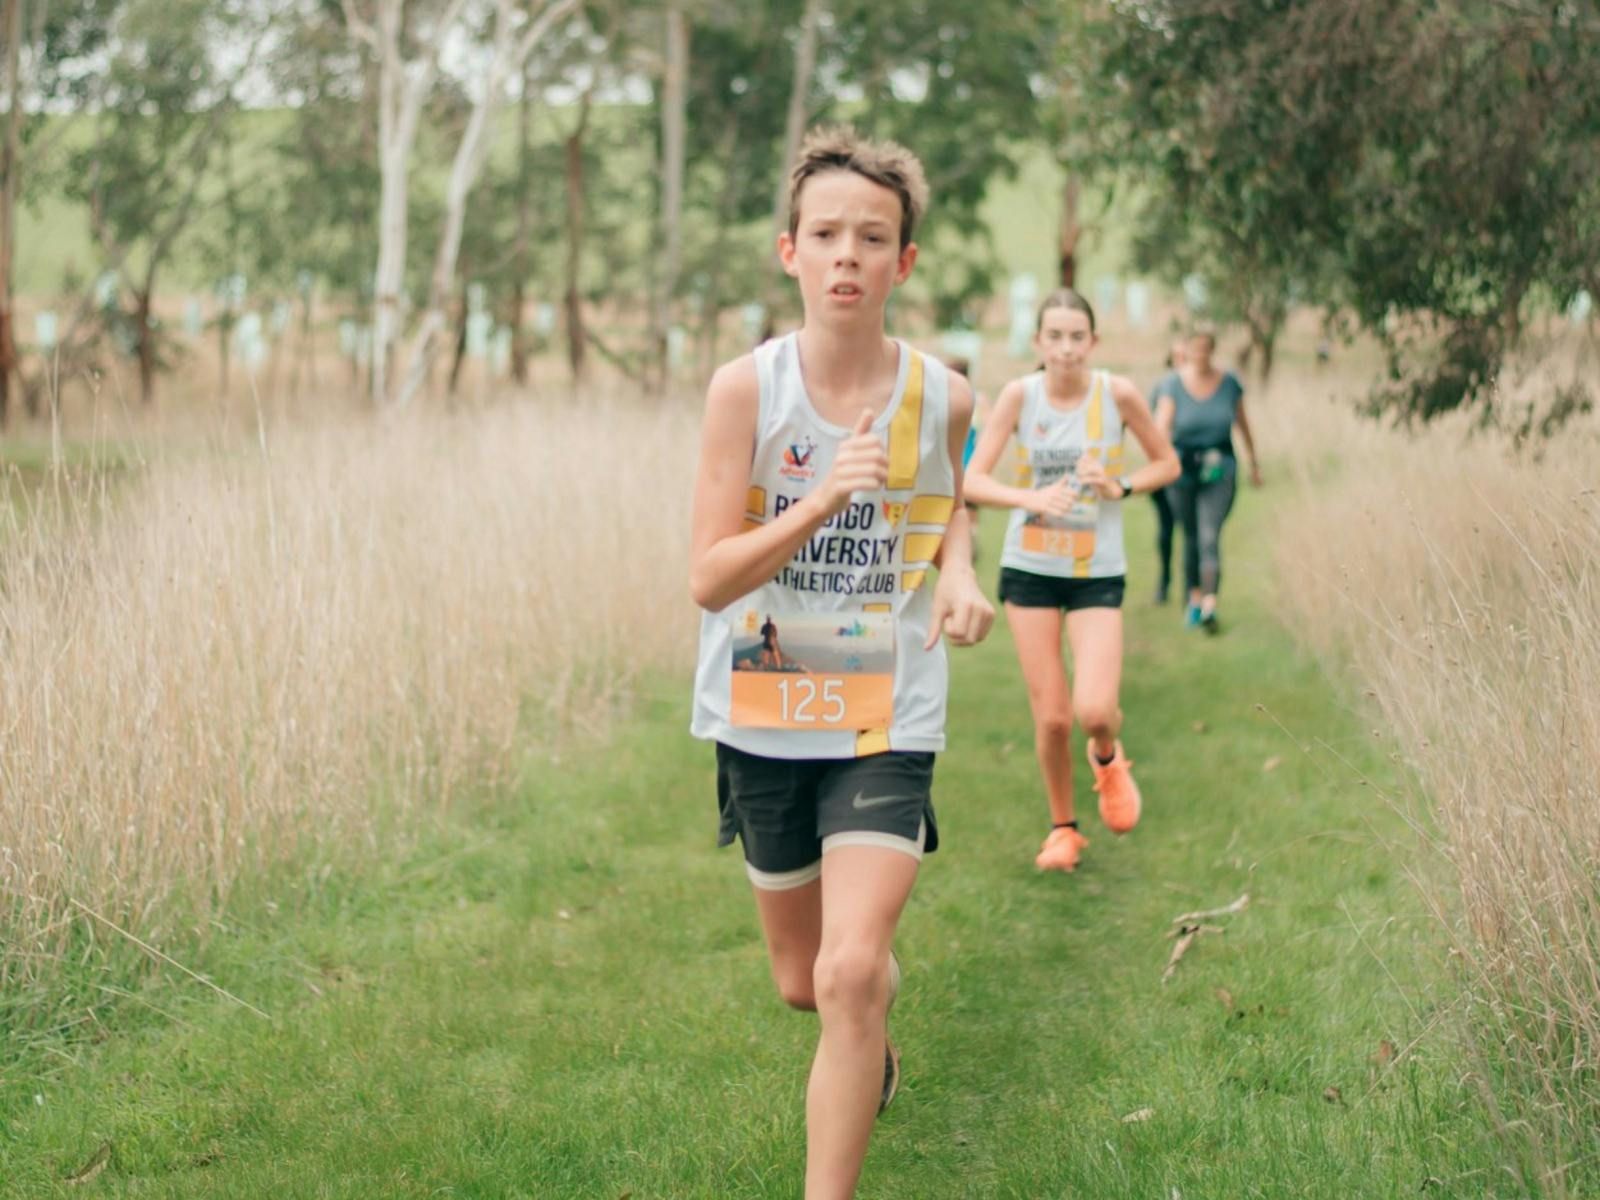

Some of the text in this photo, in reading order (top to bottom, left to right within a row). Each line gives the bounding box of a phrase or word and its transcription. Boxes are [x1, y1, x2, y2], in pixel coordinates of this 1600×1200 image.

[775, 494, 875, 531] BIGO
[793, 534, 899, 567] IVERSITY
[856, 573, 896, 595] CLUB
[777, 679, 845, 723] 125
